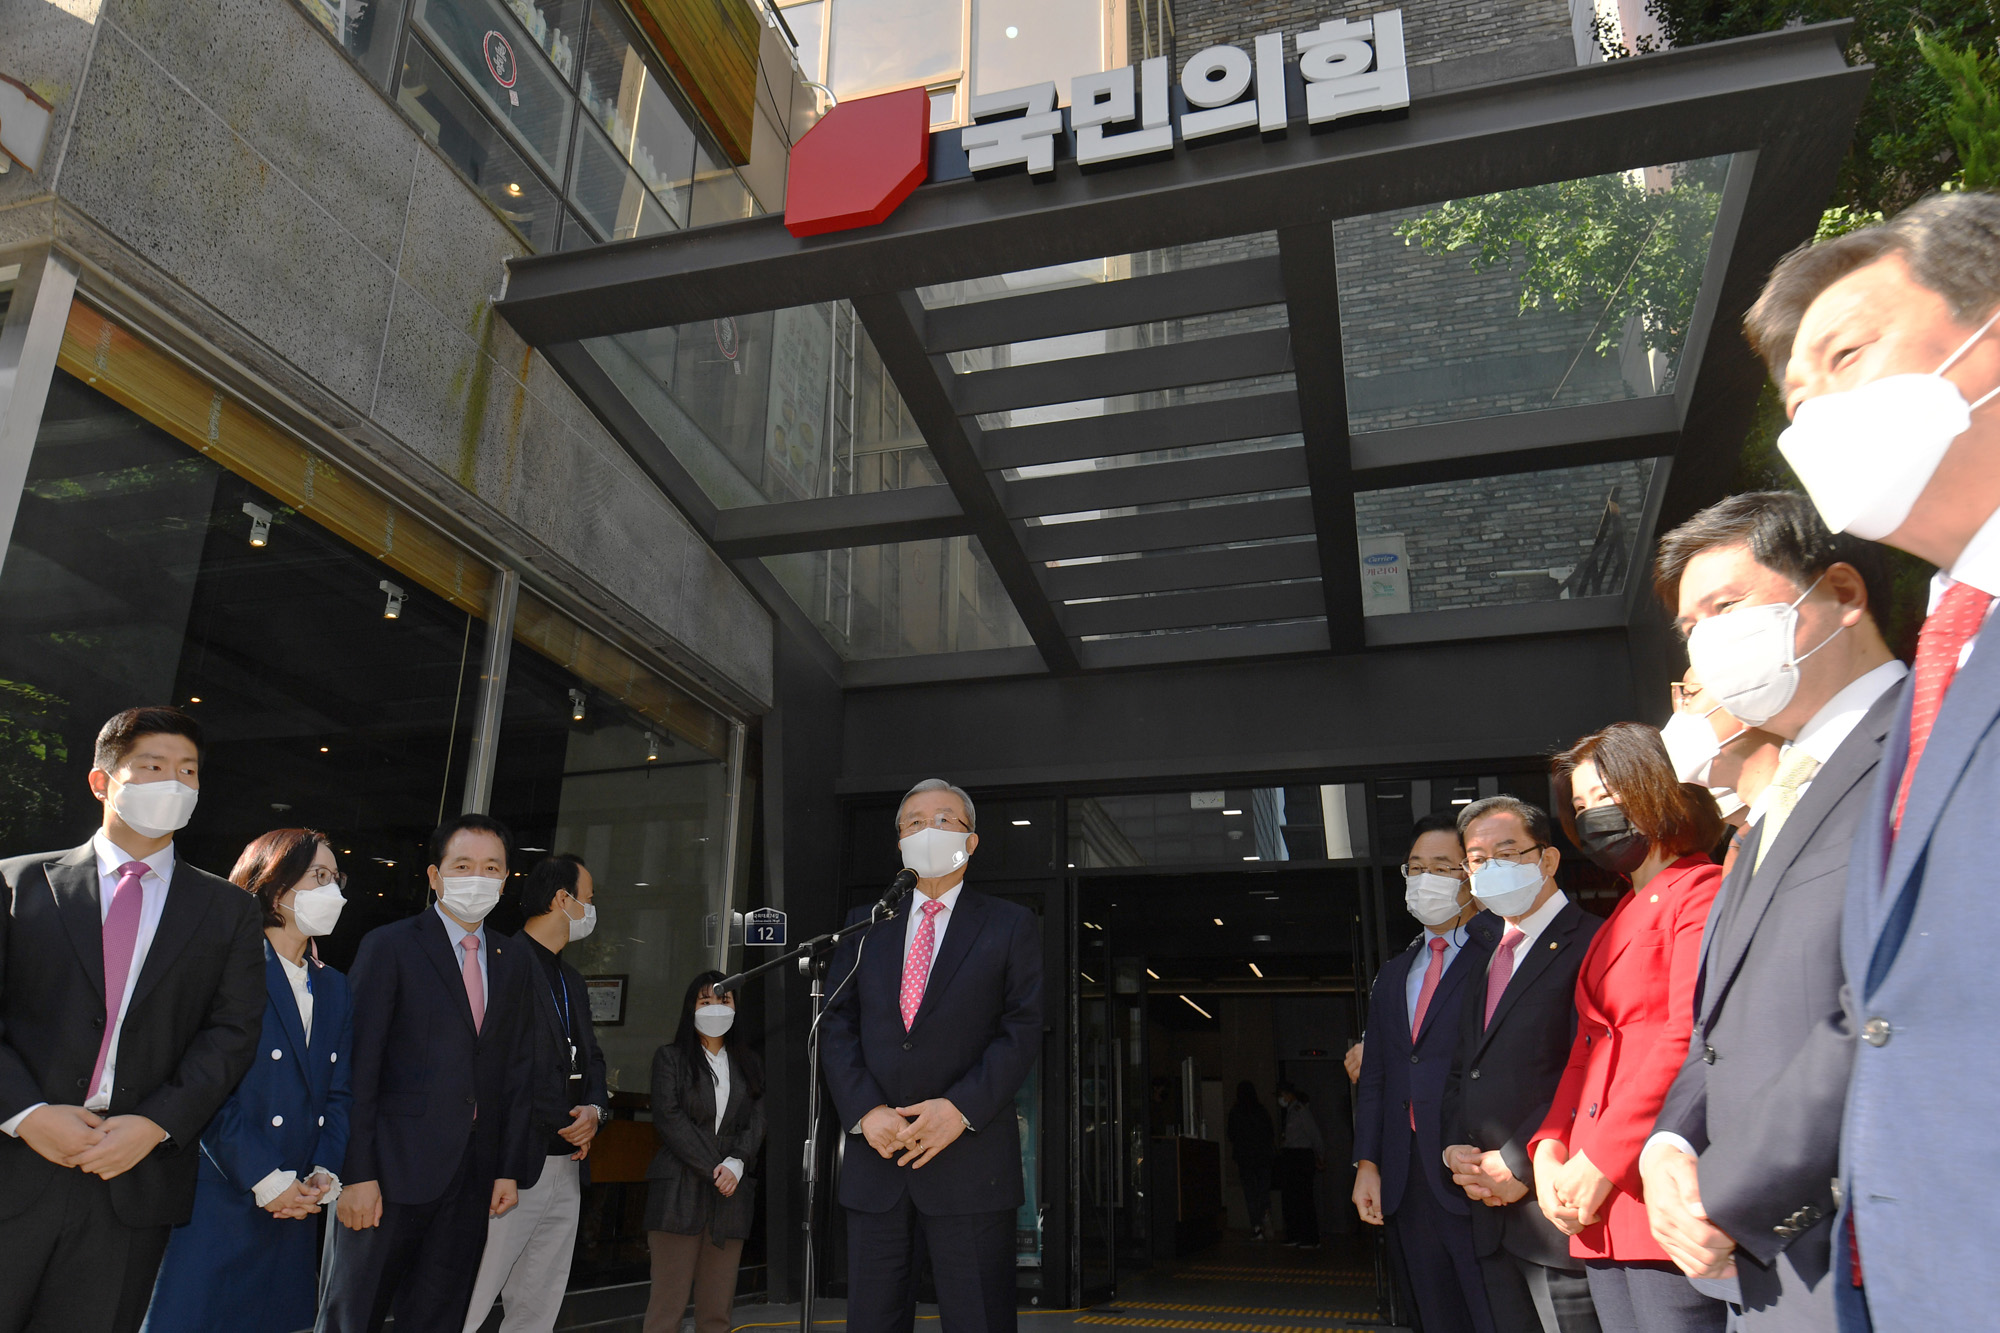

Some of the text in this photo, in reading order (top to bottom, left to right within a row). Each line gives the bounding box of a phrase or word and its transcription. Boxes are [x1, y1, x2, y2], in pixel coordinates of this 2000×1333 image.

[961, 10, 1409, 175] 국민의힘
[1366, 567, 1398, 576] 캐리어
[757, 927, 774, 941] 12
